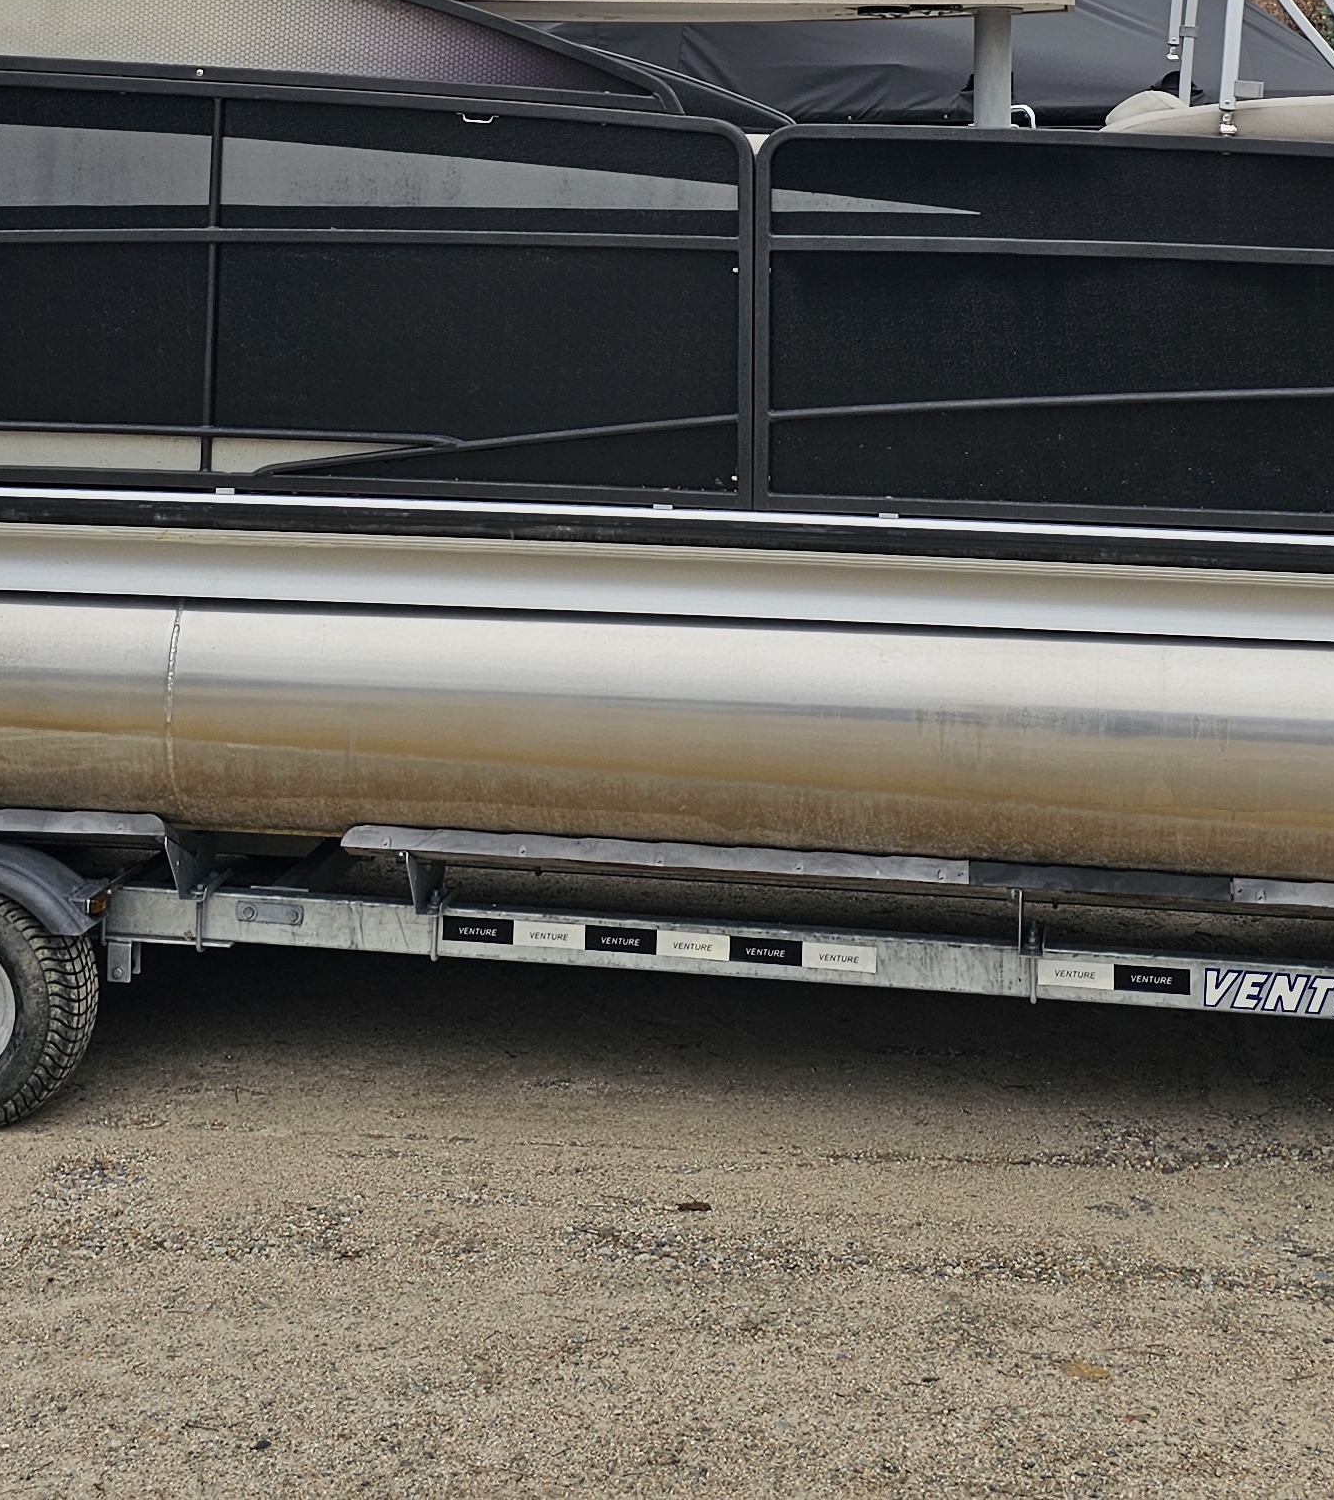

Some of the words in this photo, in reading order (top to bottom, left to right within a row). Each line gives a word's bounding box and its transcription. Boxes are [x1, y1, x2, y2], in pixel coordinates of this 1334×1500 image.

[458, 927, 498, 937] VENTURE
[529, 931, 569, 941] VENTURE
[600, 936, 641, 947] VENTURE
[672, 941, 713, 952] VENTURE
[745, 947, 786, 958] VENTURE
[818, 953, 859, 964] VENTURE
[1054, 969, 1096, 980] VENTURE
[1130, 974, 1173, 985] VENTURE
